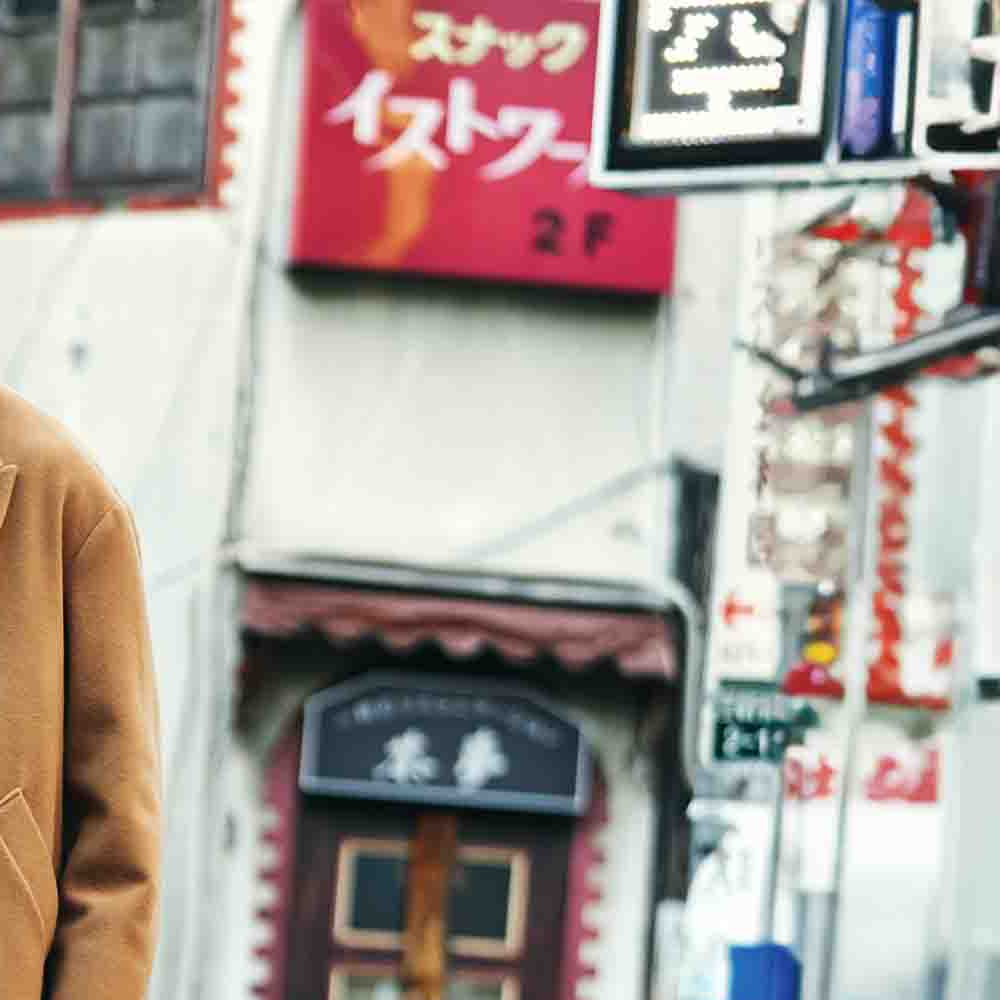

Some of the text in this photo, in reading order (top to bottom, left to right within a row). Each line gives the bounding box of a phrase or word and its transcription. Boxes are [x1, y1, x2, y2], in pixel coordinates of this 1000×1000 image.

[408, 10, 589, 73] スナック
[323, 68, 592, 190] イストワー
